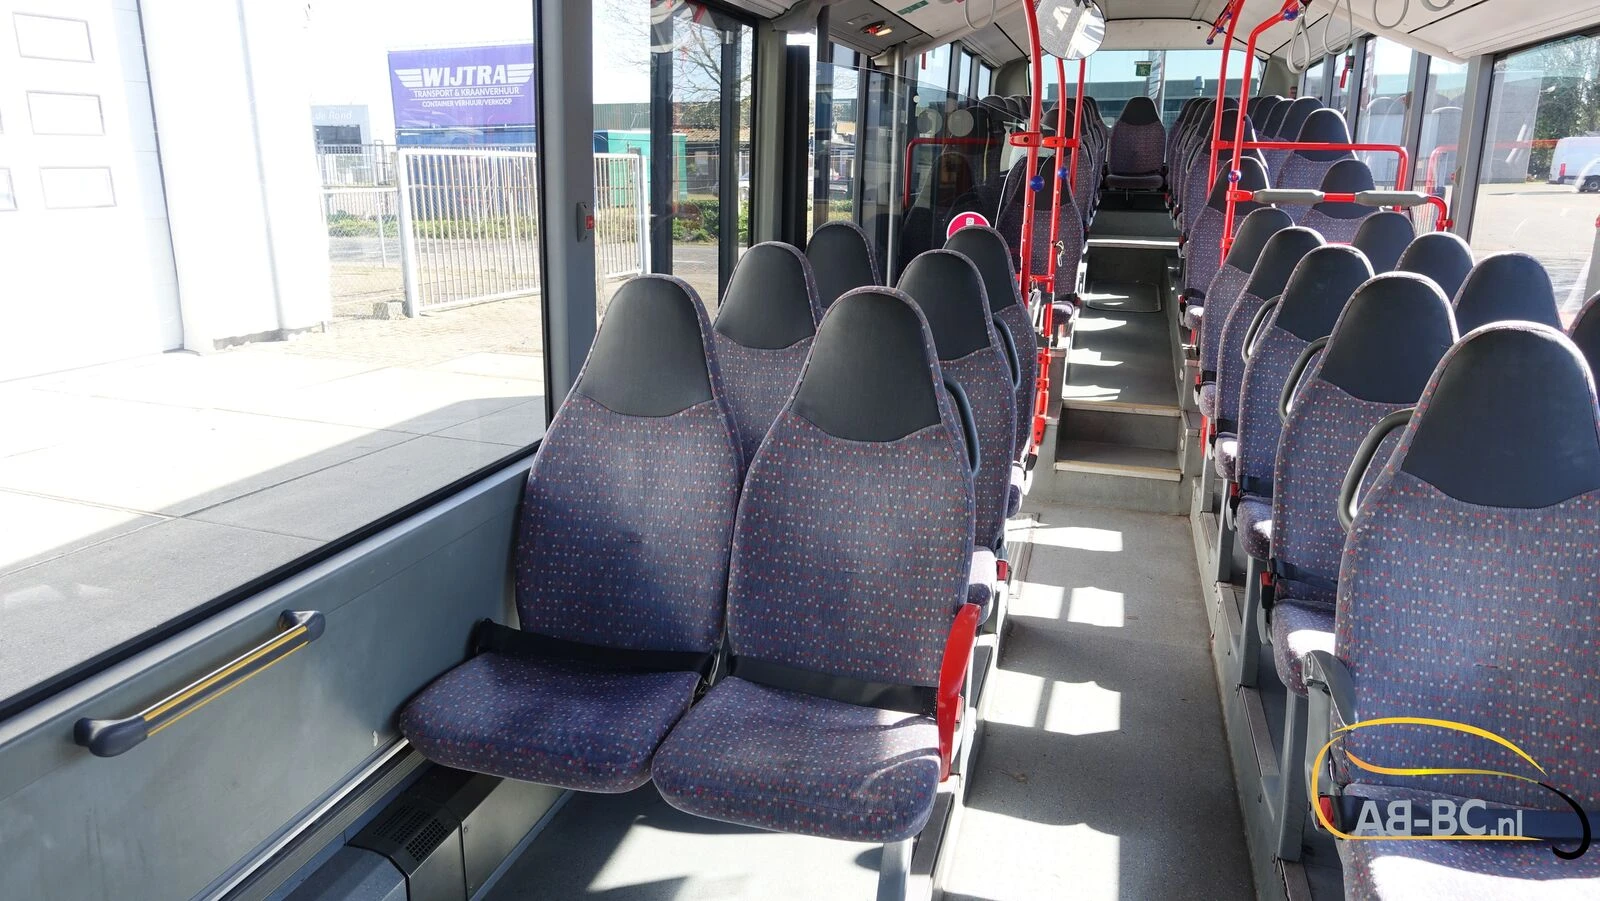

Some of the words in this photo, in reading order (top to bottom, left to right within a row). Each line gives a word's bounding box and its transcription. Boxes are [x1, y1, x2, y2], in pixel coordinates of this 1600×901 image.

[422, 65, 507, 87] WIJTRA
[414, 89, 453, 98] TRANSPORT
[461, 86, 520, 96] KRAANVERHUUR
[422, 100, 454, 108] CONTAINER
[454, 98, 513, 107] VERHUUR/VERKOOP
